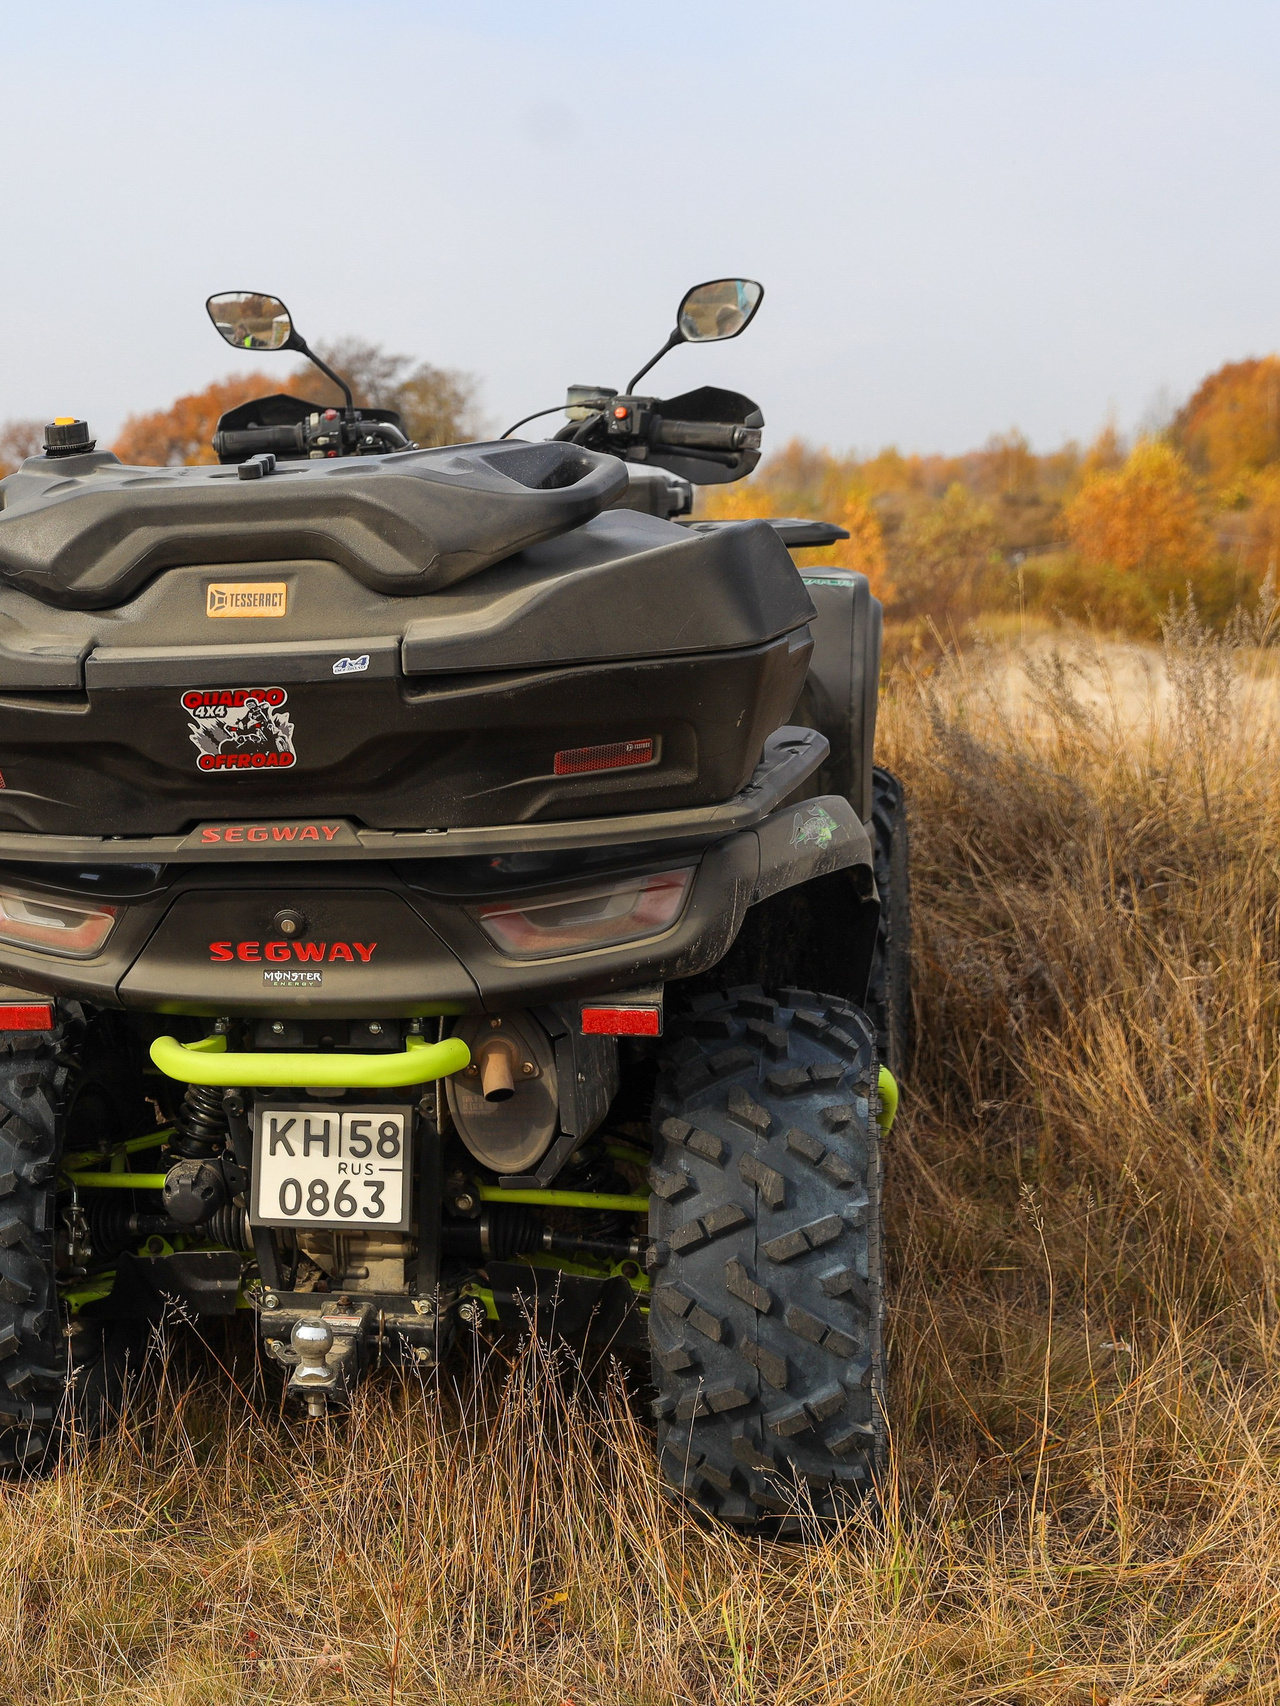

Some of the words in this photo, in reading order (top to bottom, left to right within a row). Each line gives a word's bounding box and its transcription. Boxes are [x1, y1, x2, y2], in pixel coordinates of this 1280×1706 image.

[229, 592, 283, 607] TESSERACT
[200, 752, 294, 770] OFFROAD
[200, 826, 341, 843] SEGWAY
[209, 941, 378, 963] SEGWAY
[264, 971, 322, 982] MONSTER
[269, 1118, 330, 1158] KH
[349, 1120, 400, 1159] 58
[338, 1162, 374, 1175] RUS
[279, 1178, 385, 1219] 0863
